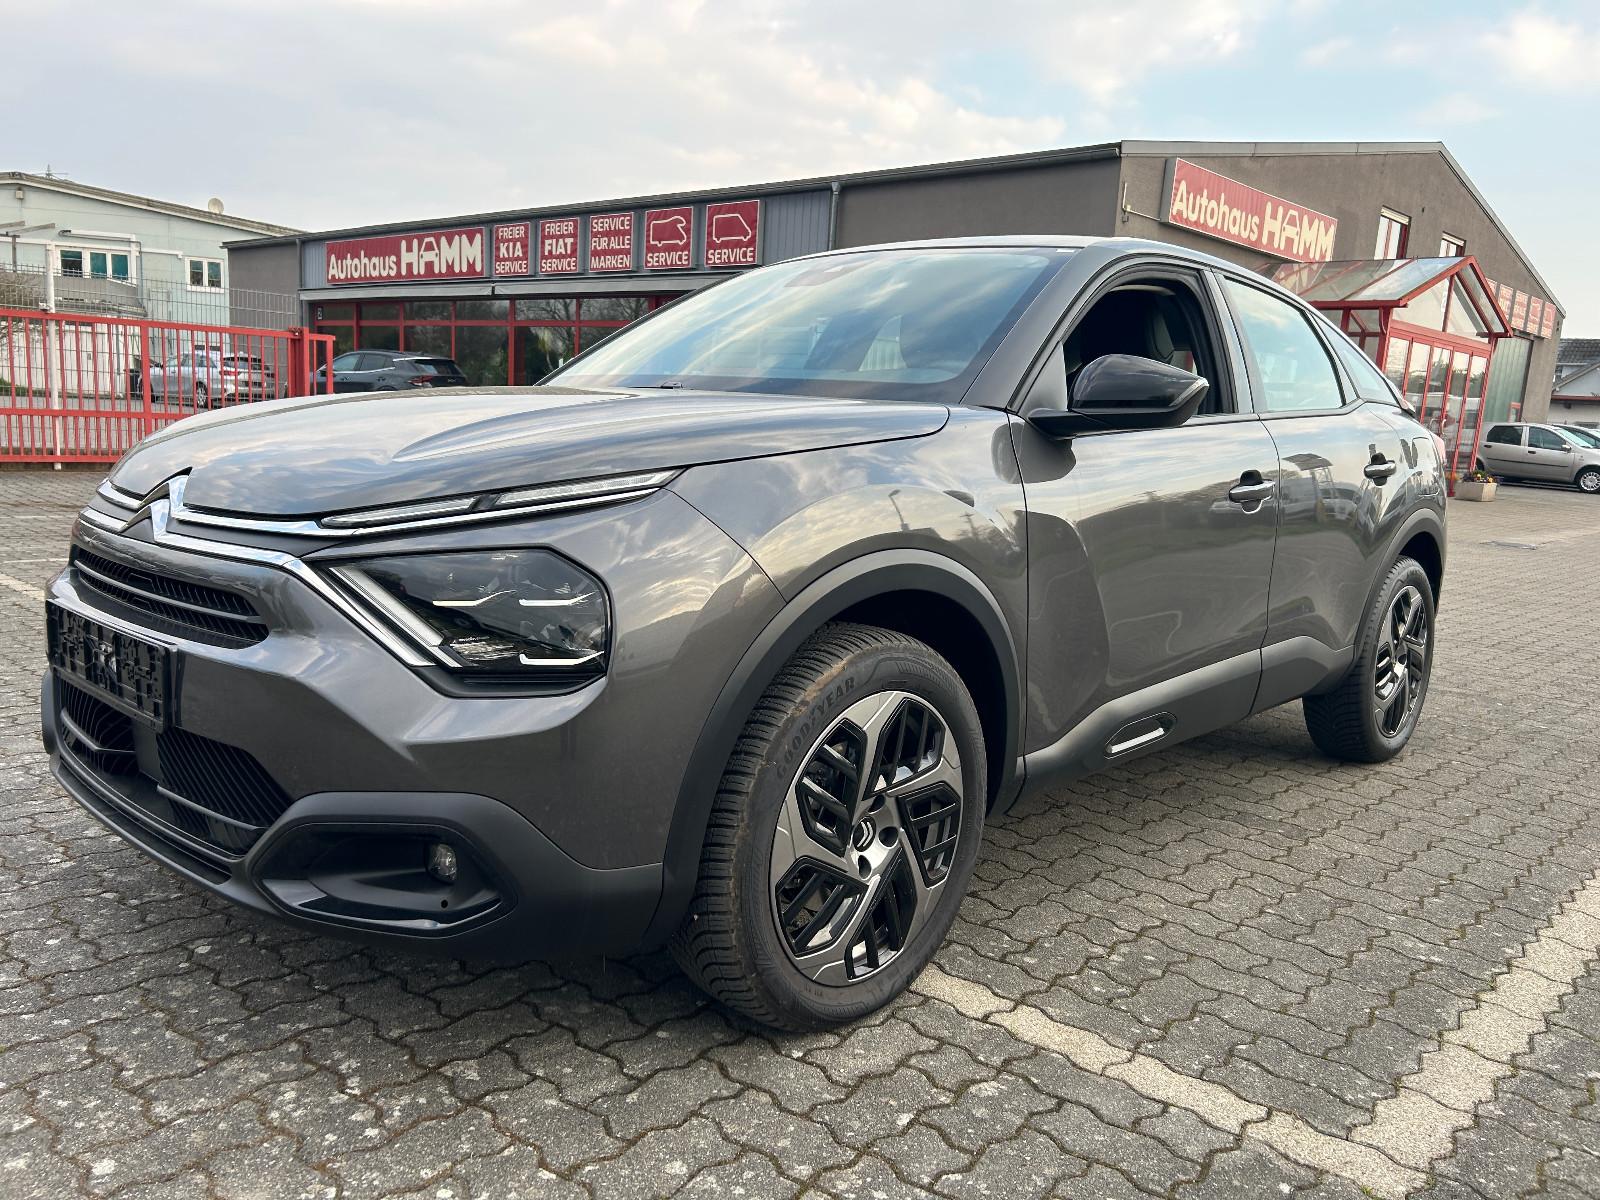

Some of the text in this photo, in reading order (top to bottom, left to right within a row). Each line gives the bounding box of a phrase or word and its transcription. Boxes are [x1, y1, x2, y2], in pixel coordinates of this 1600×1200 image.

[545, 221, 574, 235] FREIER
[592, 216, 631, 232] SERVICE
[1172, 180, 1335, 262] Autohaus HAMM
[498, 225, 525, 240] FREIER
[499, 241, 523, 258] KIA
[544, 238, 574, 255] FIAT
[591, 235, 631, 251] FÜR ALLE
[328, 233, 482, 280] Autohaus HAMM
[590, 254, 631, 269] MARKEN
[646, 251, 689, 267] SERVICE
[707, 247, 754, 264] SERVICE
[495, 260, 528, 274] SERVICE
[541, 257, 577, 272] SERVICE
